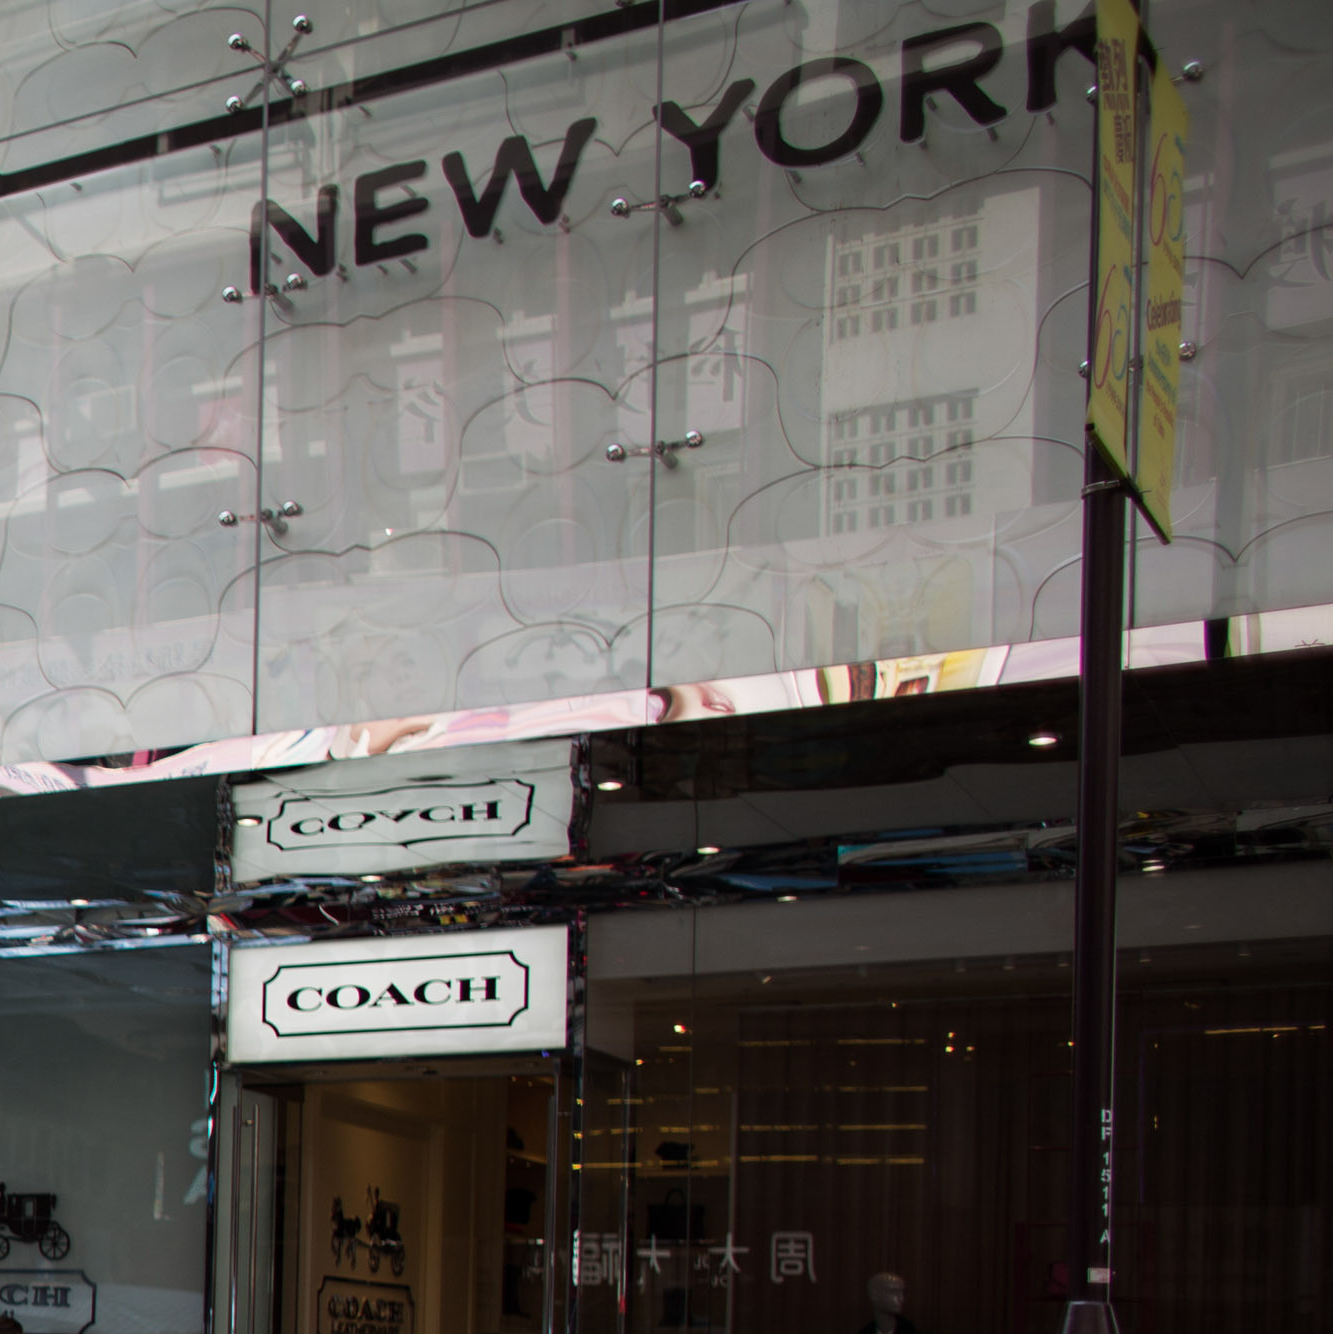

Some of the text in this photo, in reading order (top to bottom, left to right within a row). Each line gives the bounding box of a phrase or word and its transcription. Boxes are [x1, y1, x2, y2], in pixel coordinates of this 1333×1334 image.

[250, 117, 597, 294] NEW
[285, 976, 502, 1011] COACH
[327, 1296, 405, 1324] COACH
